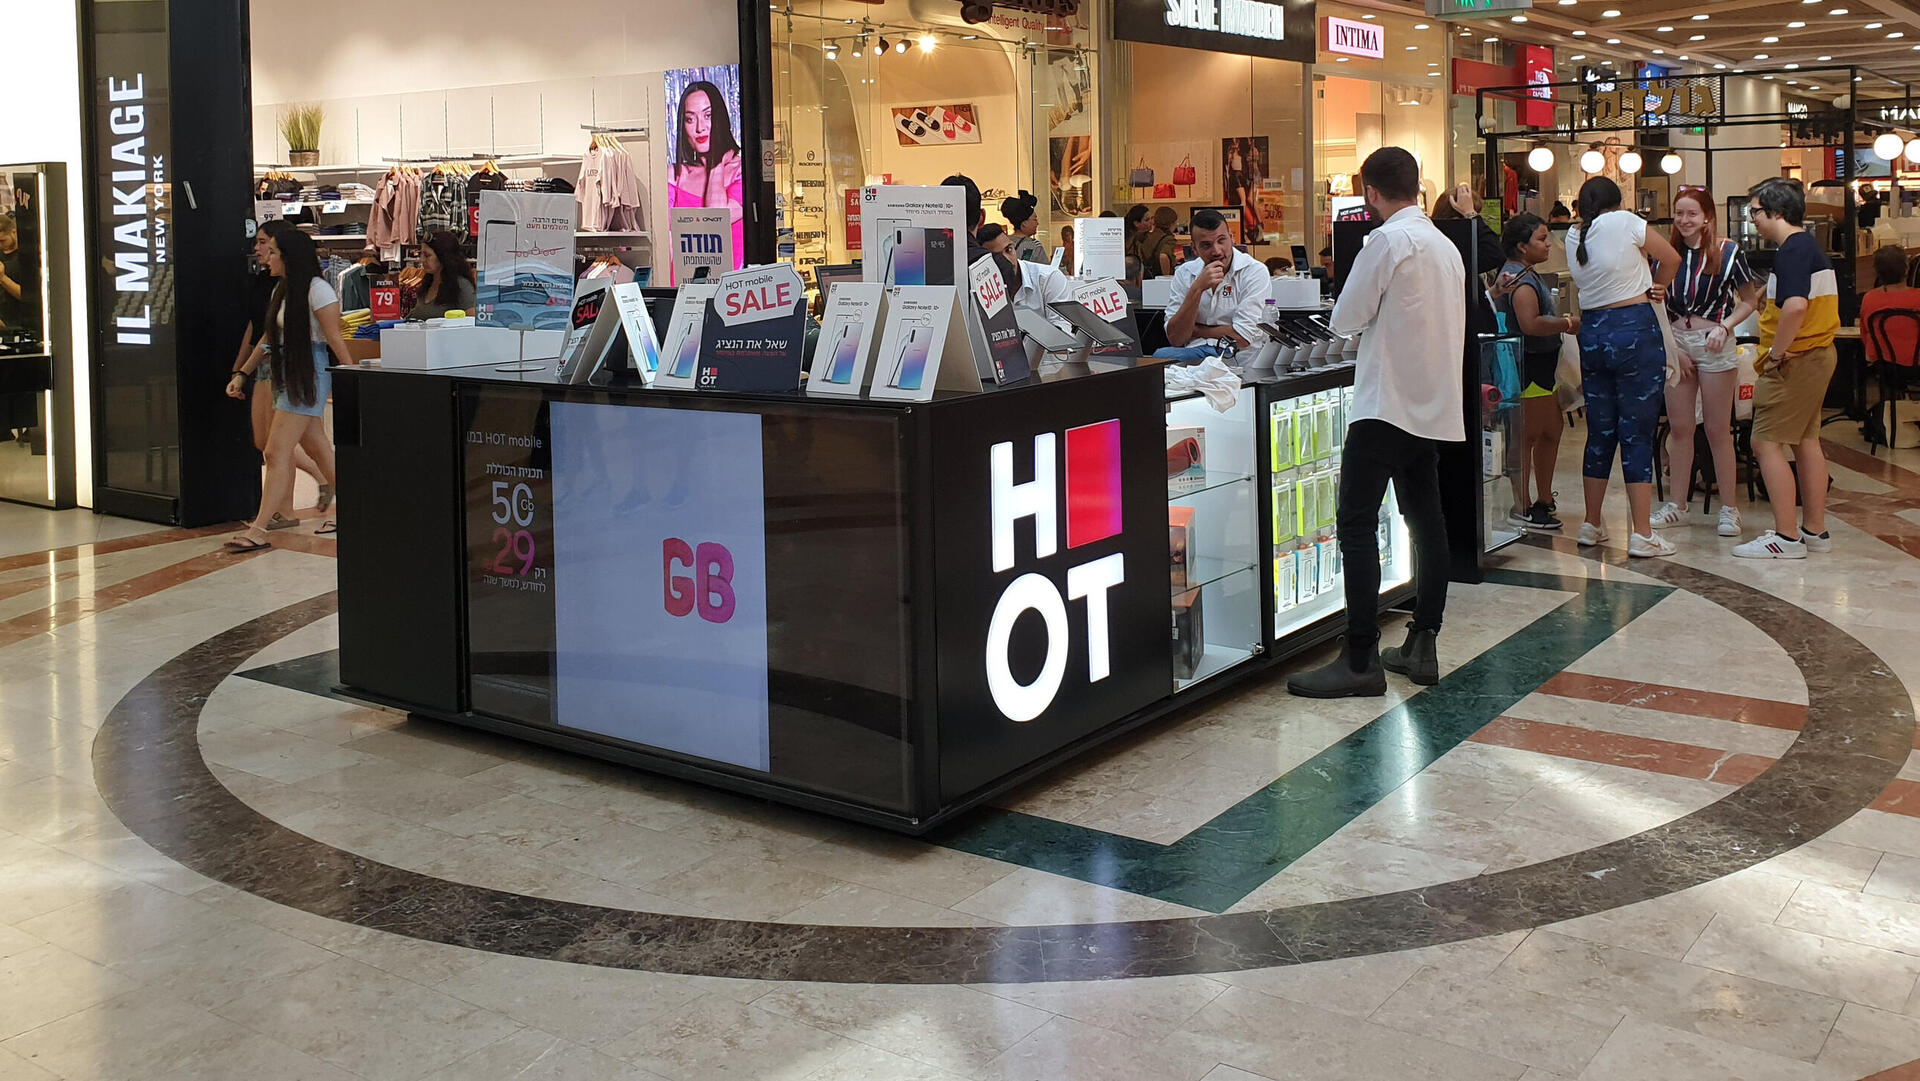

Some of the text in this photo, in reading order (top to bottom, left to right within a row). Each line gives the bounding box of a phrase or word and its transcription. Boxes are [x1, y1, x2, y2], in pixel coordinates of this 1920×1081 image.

[1022, 17, 1044, 33] Quality
[1335, 24, 1378, 50] INTIMA
[109, 73, 151, 345] IL MAKIAGE
[153, 154, 166, 263] NEW YORK
[680, 233, 723, 254] תודה
[725, 280, 744, 291] HOT
[746, 275, 774, 287] mobile
[979, 272, 1005, 310] SALE
[1077, 286, 1107, 301] HOT mobile
[725, 282, 793, 317] SALE
[715, 338, 788, 349] שאל את הנציג
[485, 431, 506, 446] HOT
[508, 434, 542, 449] mobile
[485, 463, 543, 479] תכנית הכוללת
[491, 526, 535, 576] 29
[534, 567, 546, 579] רק
[662, 537, 737, 624] GB
